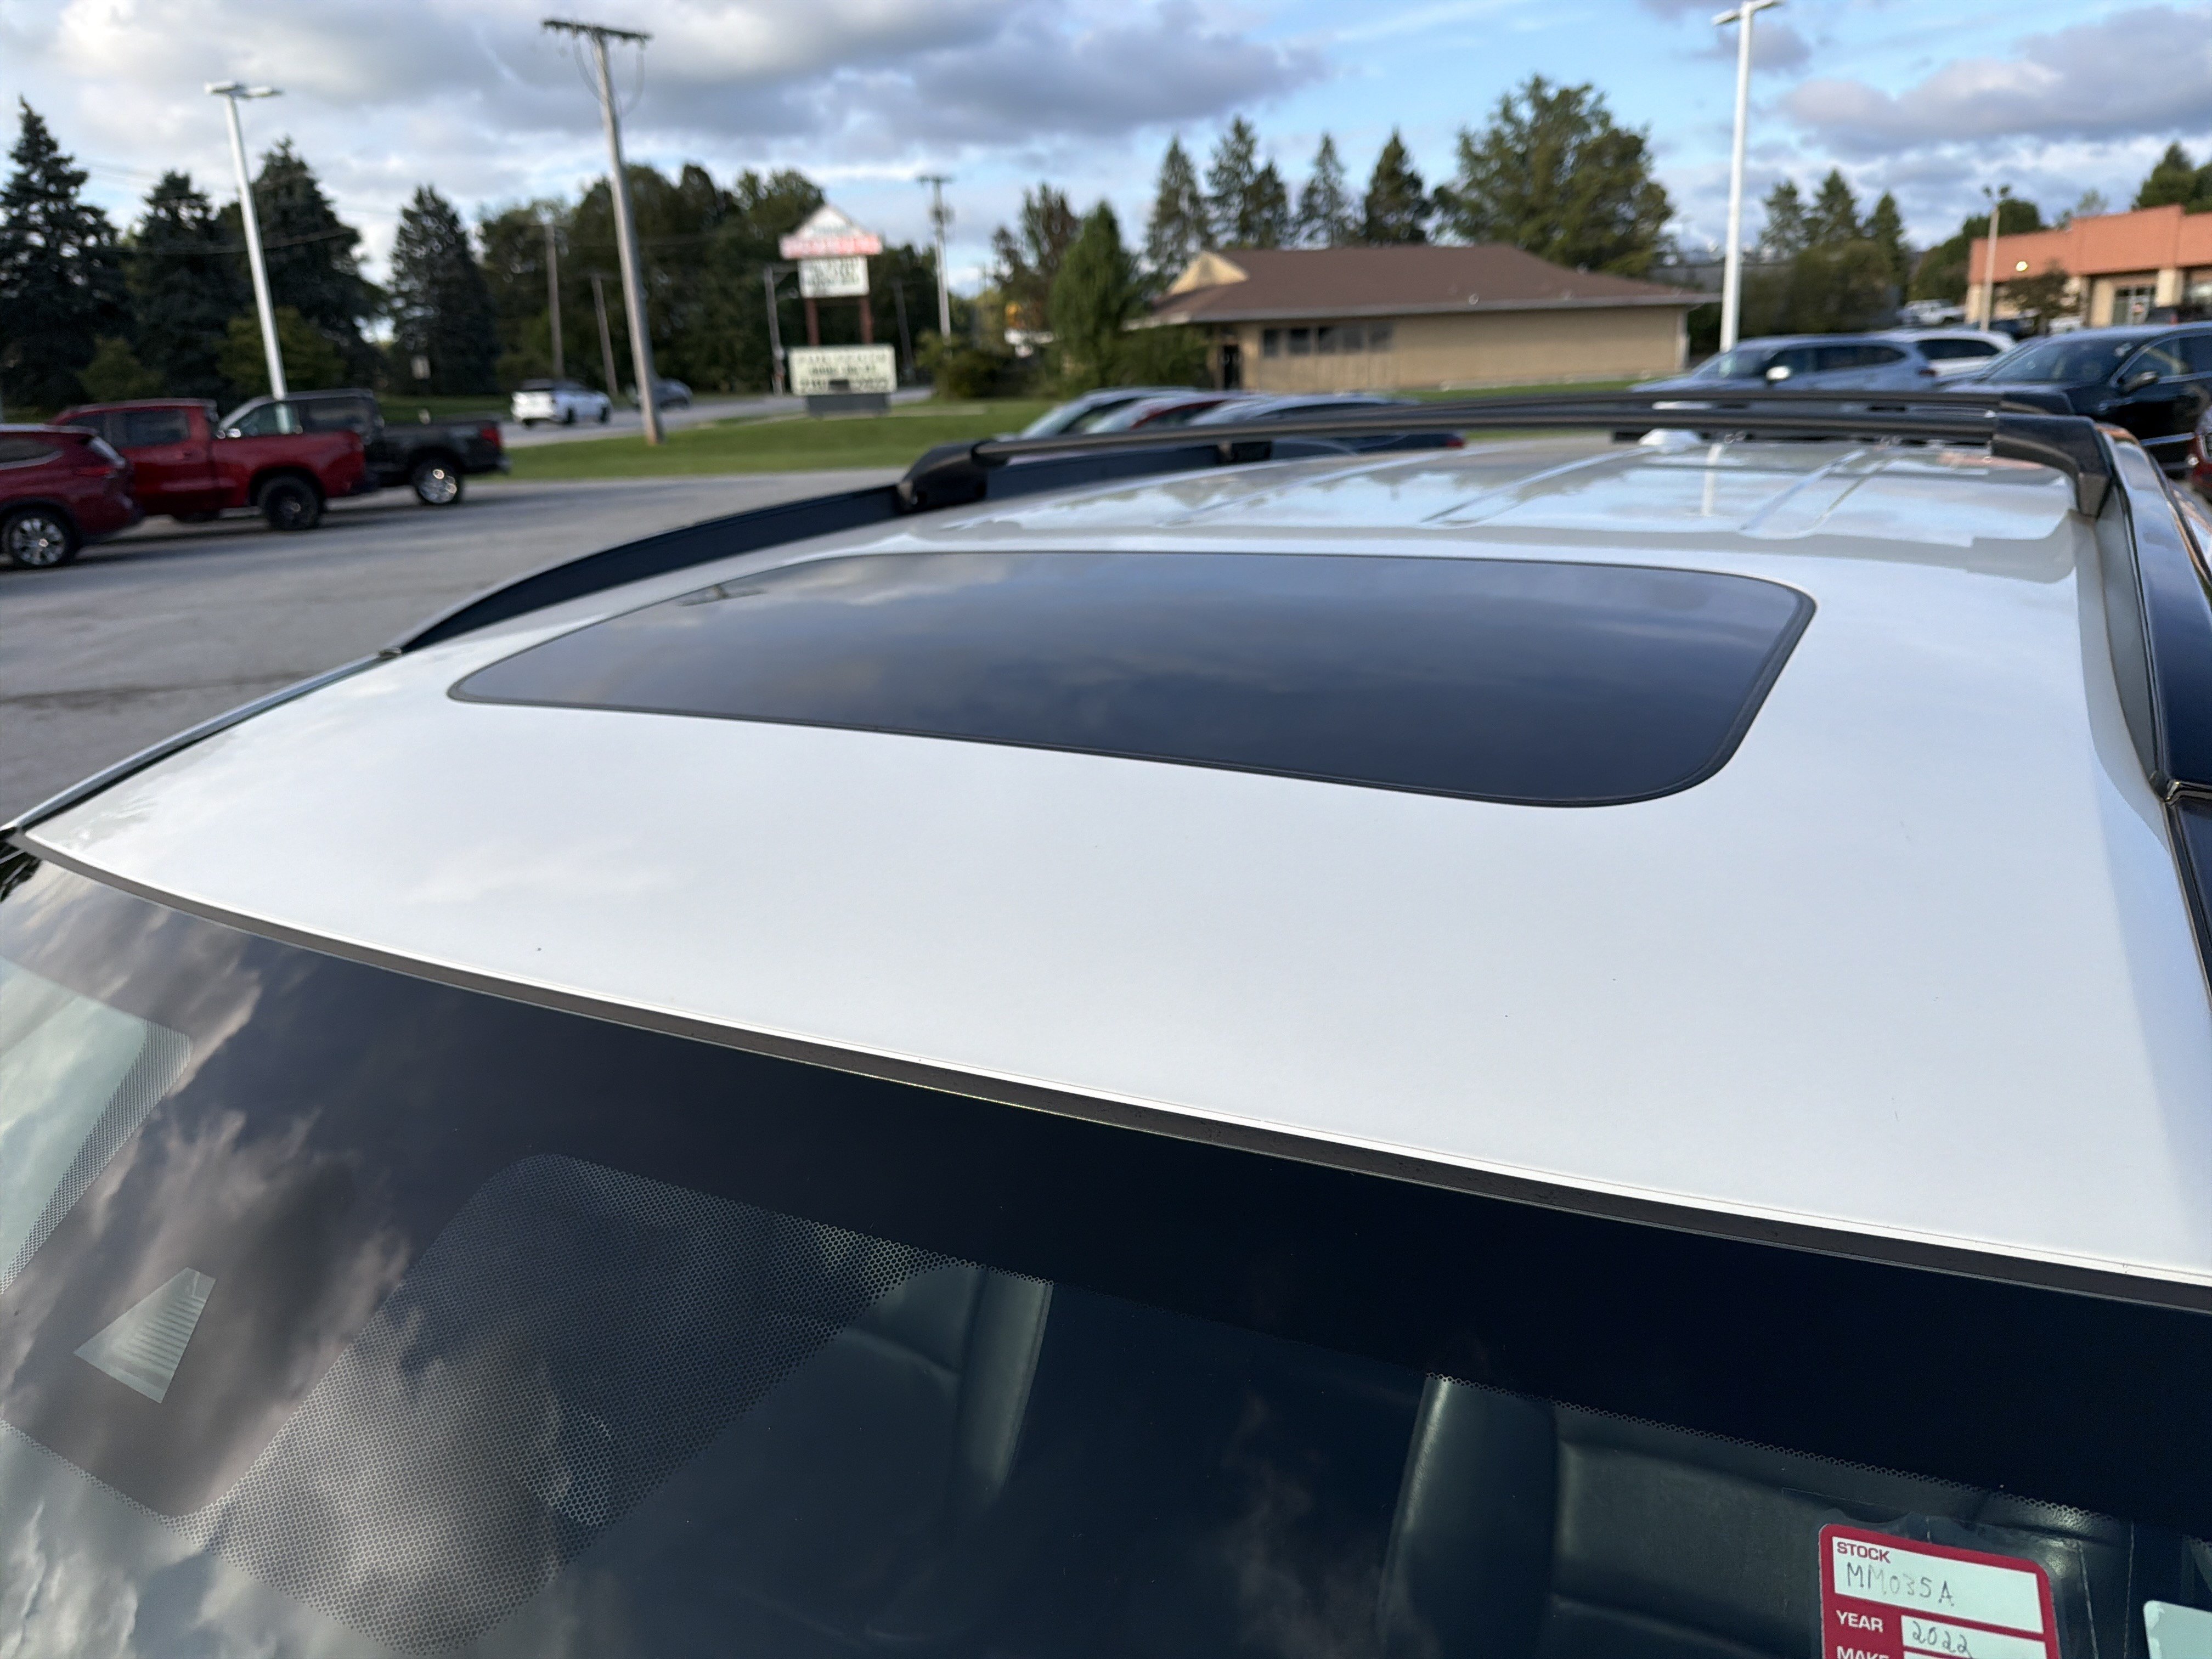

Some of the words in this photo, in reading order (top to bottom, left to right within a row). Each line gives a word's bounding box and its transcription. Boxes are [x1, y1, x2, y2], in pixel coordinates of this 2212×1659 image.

[1837, 1541, 1891, 1564] STOCK
[1836, 1609, 1883, 1633] YEAR
[1912, 1620, 1973, 1658] 2022
[1837, 1645, 1891, 1659] MAK
